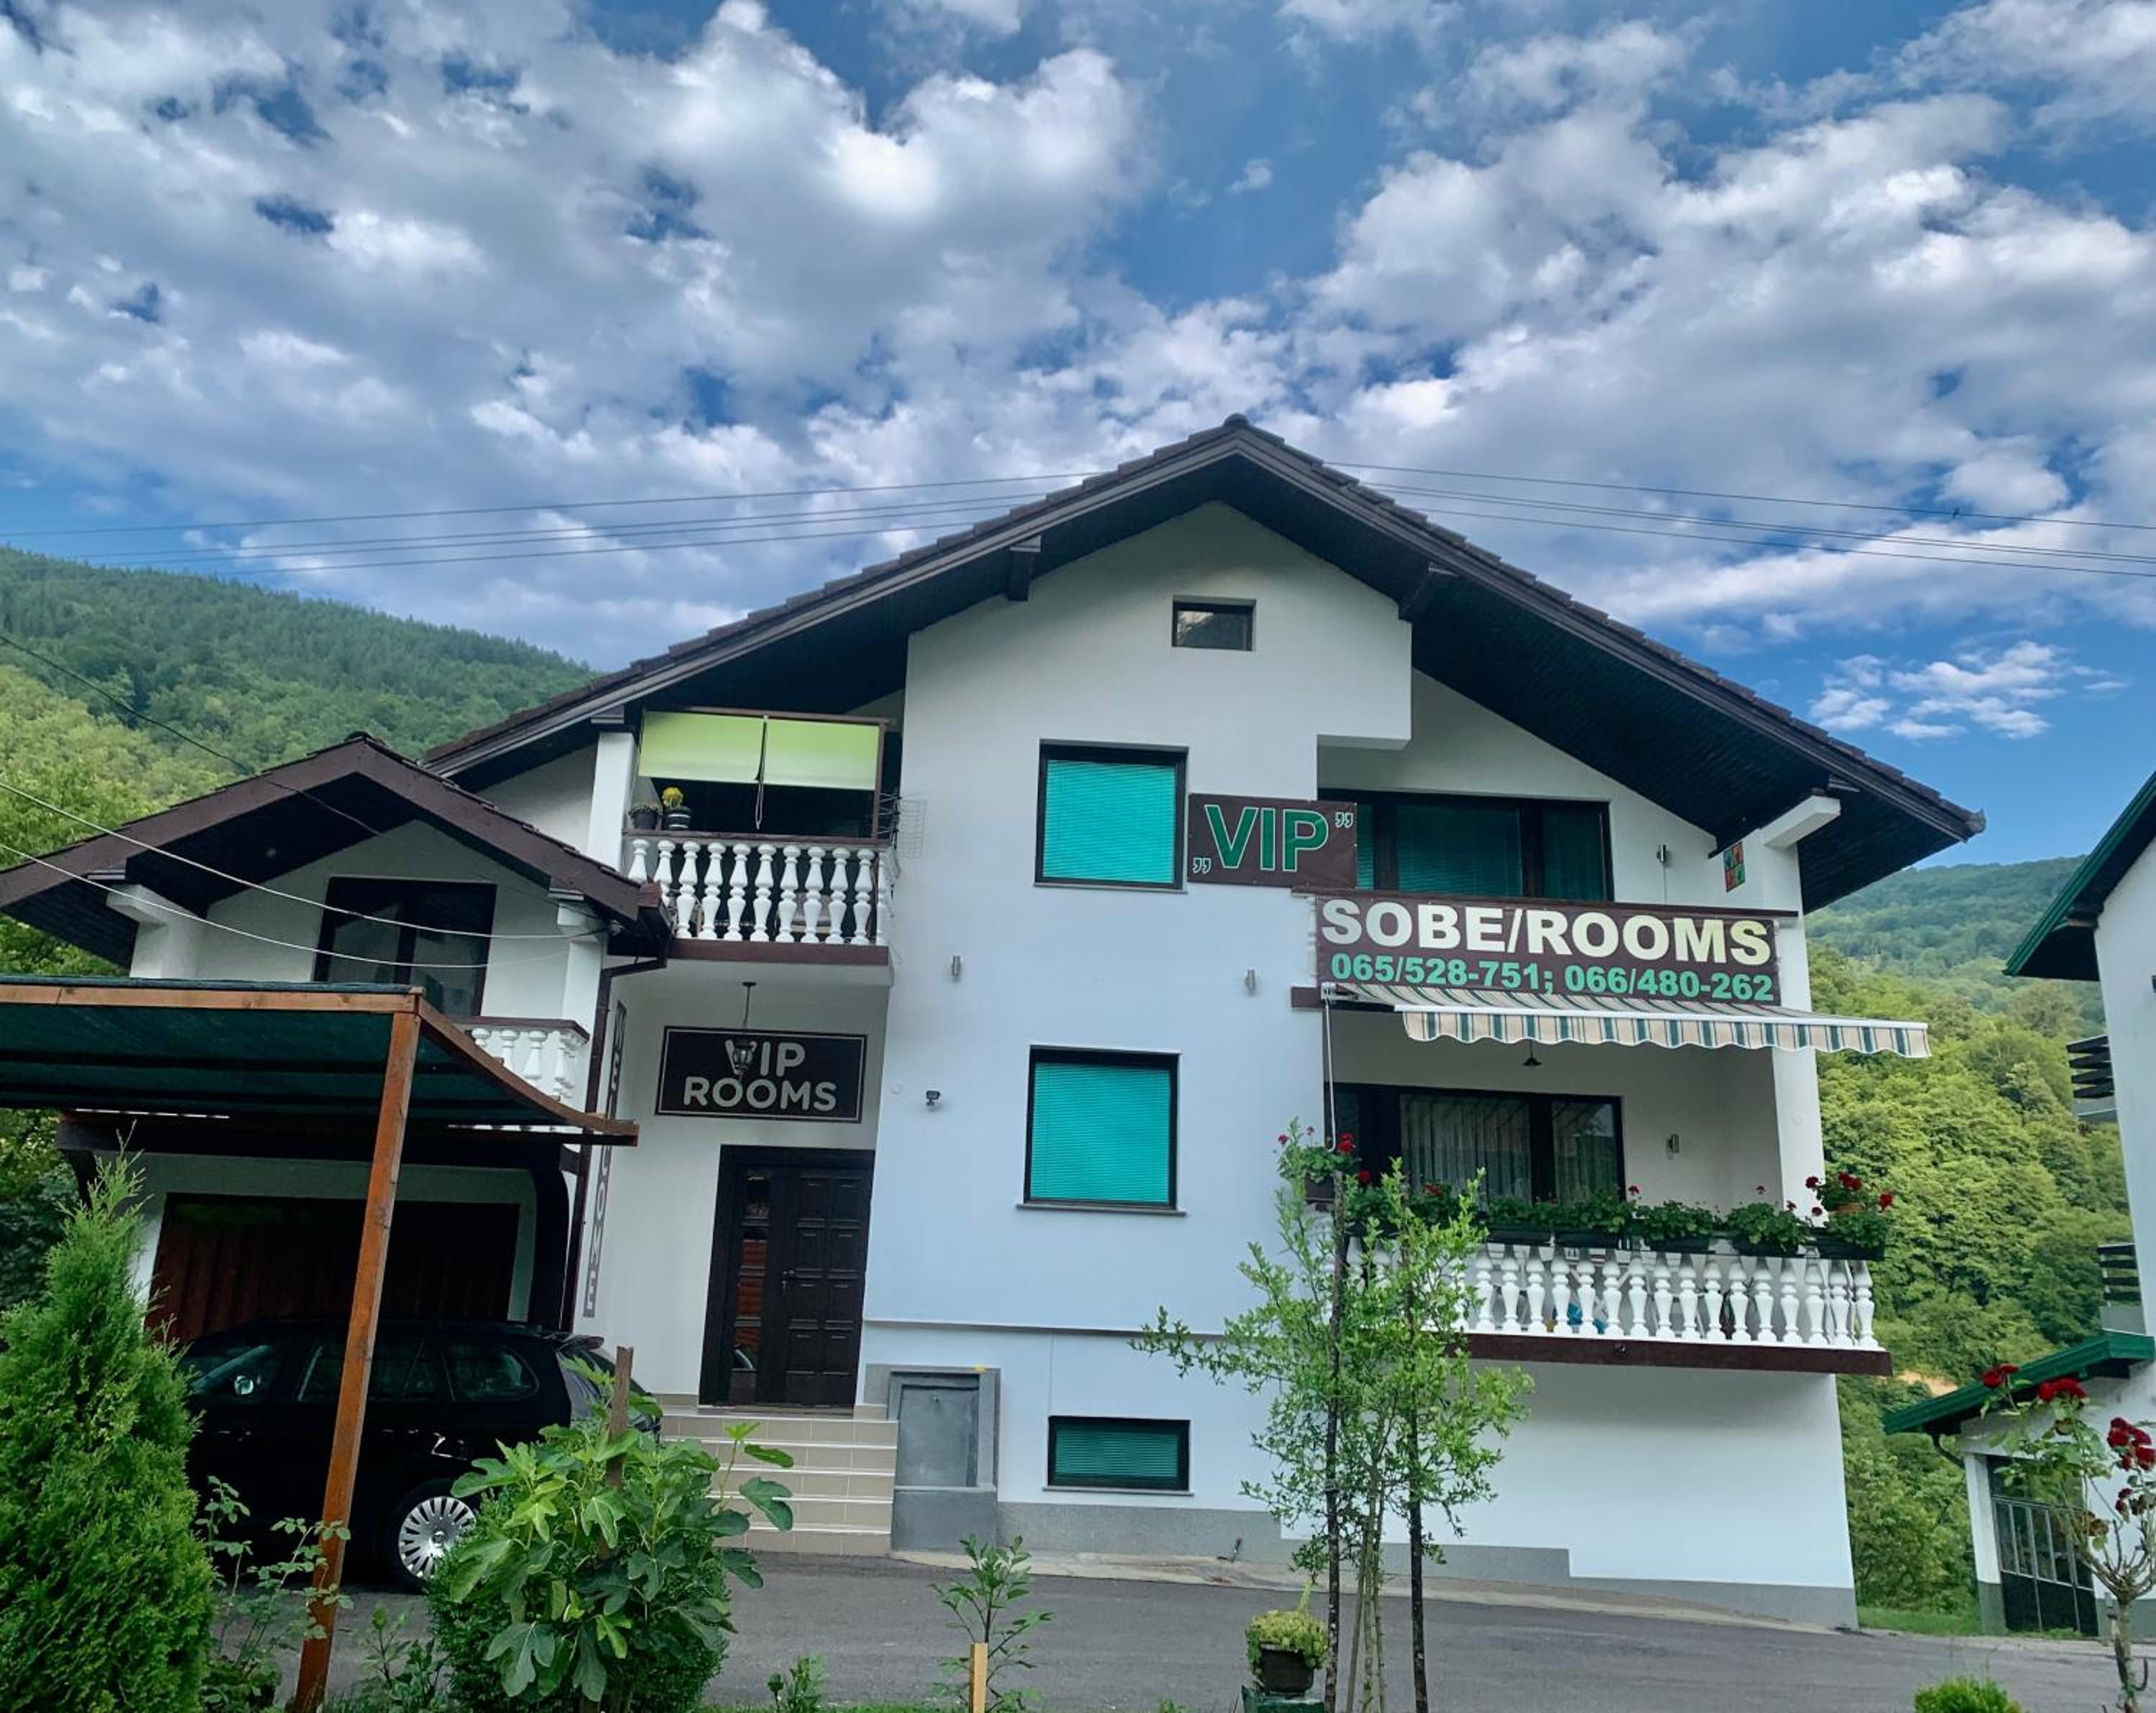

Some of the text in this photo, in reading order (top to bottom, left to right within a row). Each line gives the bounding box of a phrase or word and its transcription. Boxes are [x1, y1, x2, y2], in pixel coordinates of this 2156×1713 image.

[1322, 899, 1771, 966] SOBE/ROOMS
[1332, 953, 1774, 1001] 065/528-751; 066/480-262
[683, 1076, 837, 1111] ROOMS
